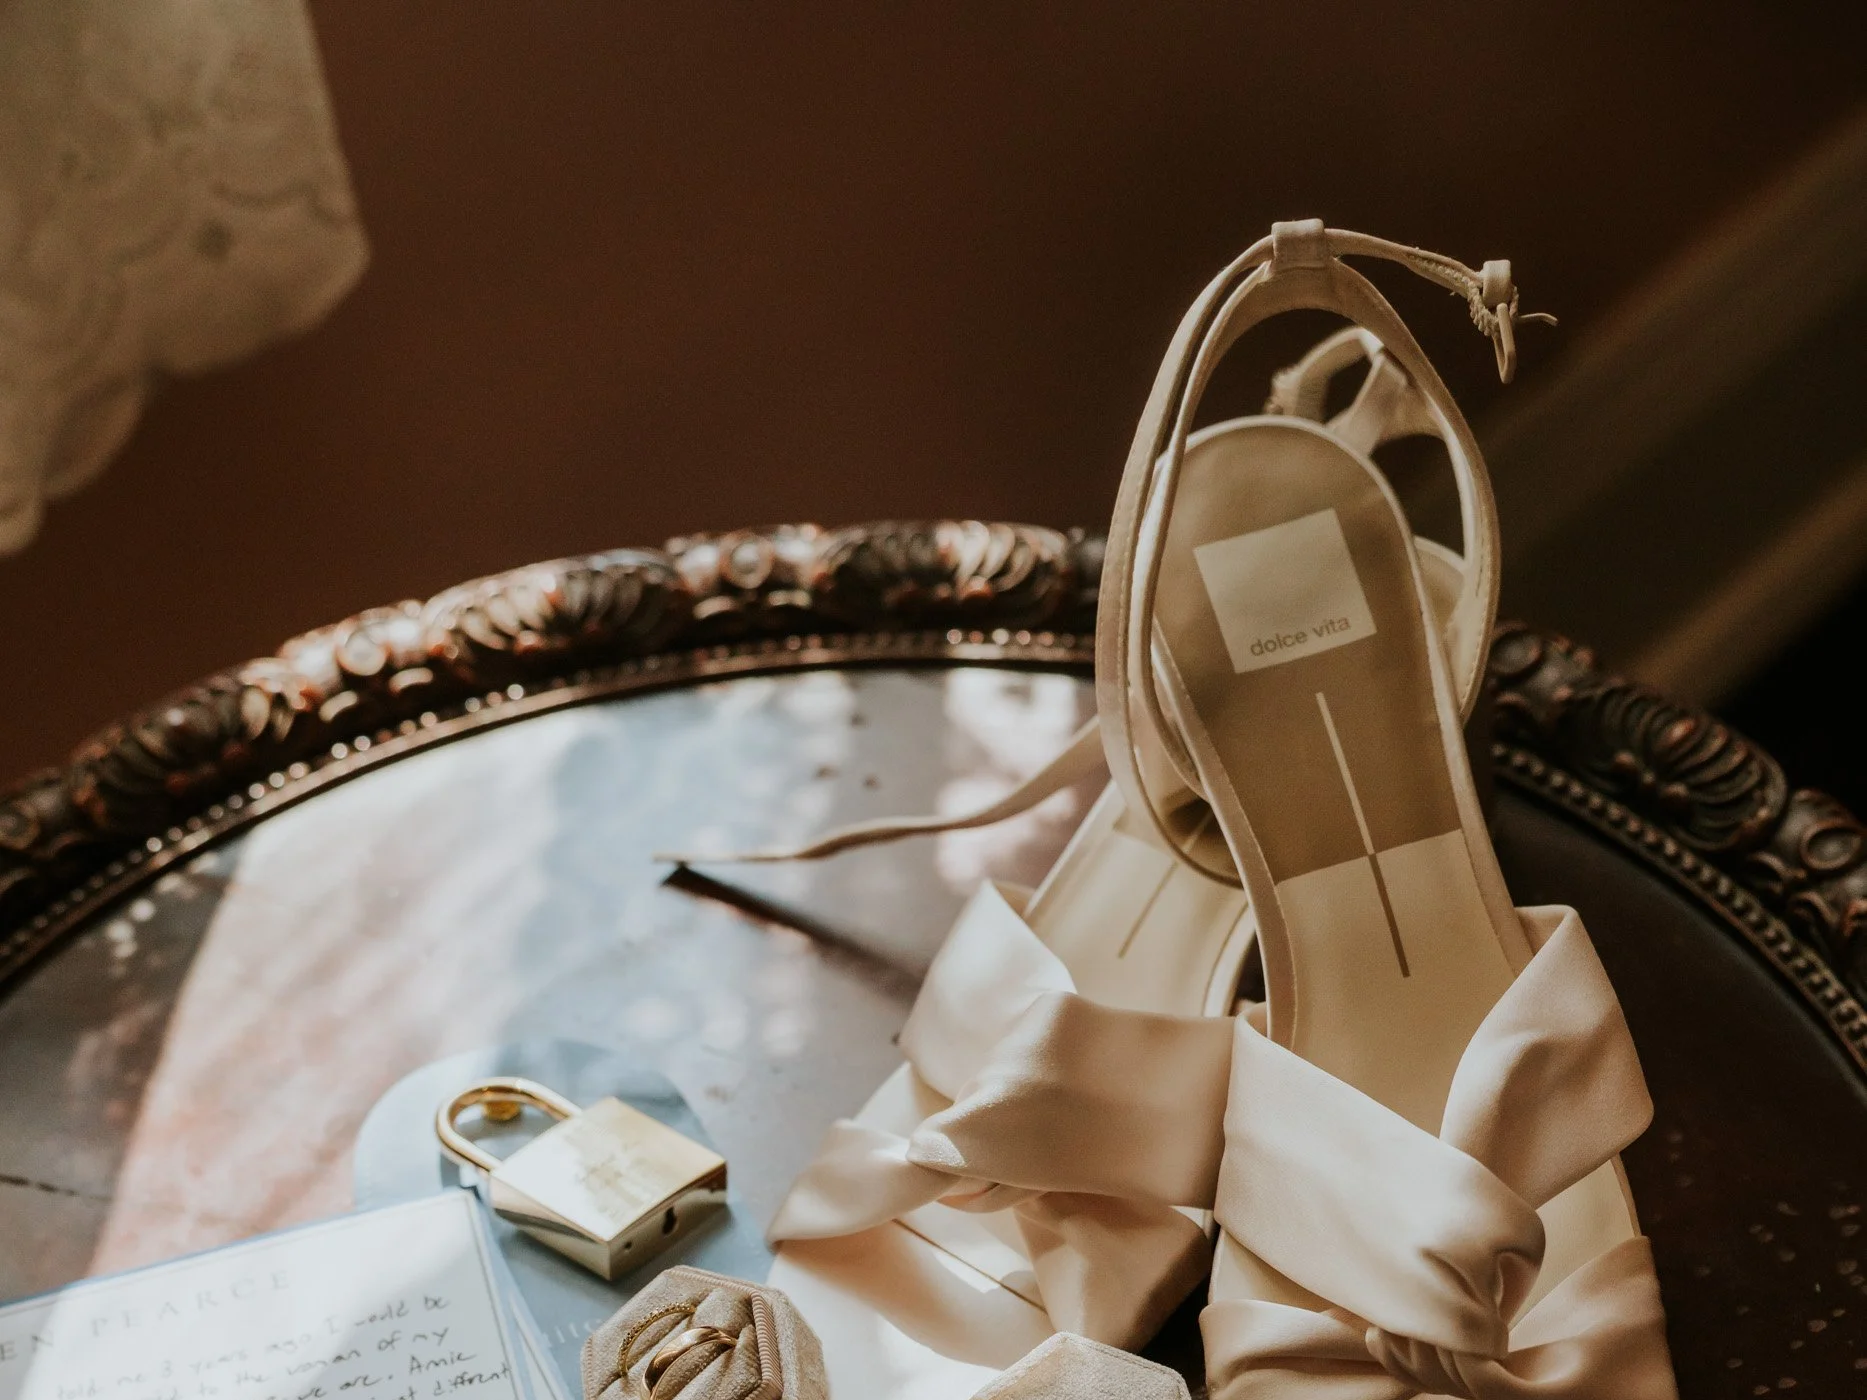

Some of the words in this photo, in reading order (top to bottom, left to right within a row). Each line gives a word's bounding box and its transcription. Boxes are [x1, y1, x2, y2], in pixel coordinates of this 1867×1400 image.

[1250, 632, 1308, 657] dolce
[1312, 616, 1352, 638] vita
[89, 1269, 290, 1338] PEARCE
[323, 1314, 339, 1334] I
[354, 1300, 409, 1327] would
[424, 1294, 450, 1310] be
[198, 1381, 219, 1397] to
[286, 1349, 362, 1376] woman
[377, 1329, 401, 1351] of
[412, 1326, 449, 1346] my
[298, 1385, 327, 1400] we
